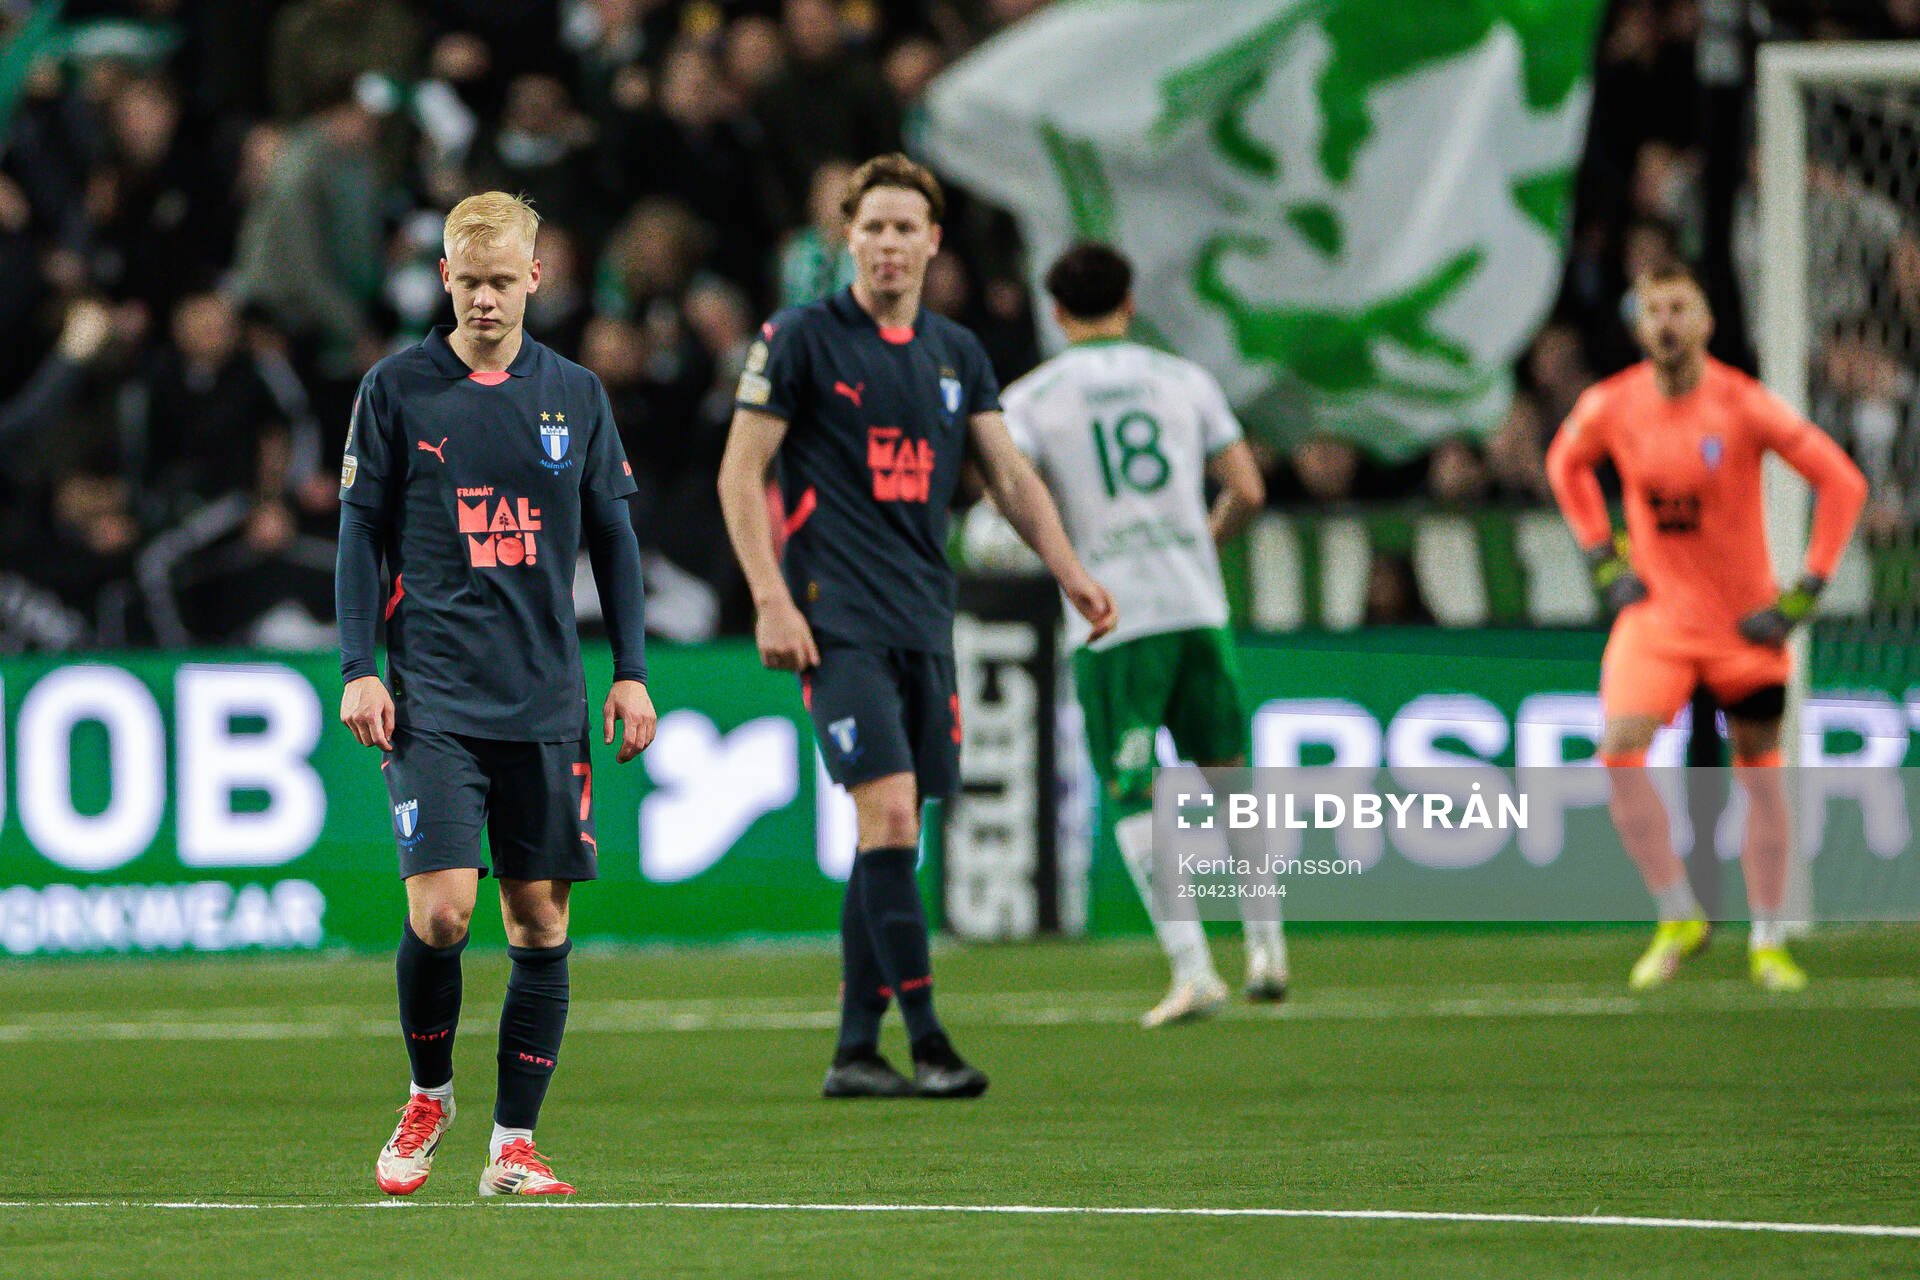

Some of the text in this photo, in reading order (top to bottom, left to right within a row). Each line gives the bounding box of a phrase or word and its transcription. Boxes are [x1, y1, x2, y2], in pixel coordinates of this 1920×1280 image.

[457, 484, 494, 497] FRAMÅT
[1090, 410, 1172, 498] 18
[0, 662, 327, 873] OB
[571, 762, 592, 821] 7
